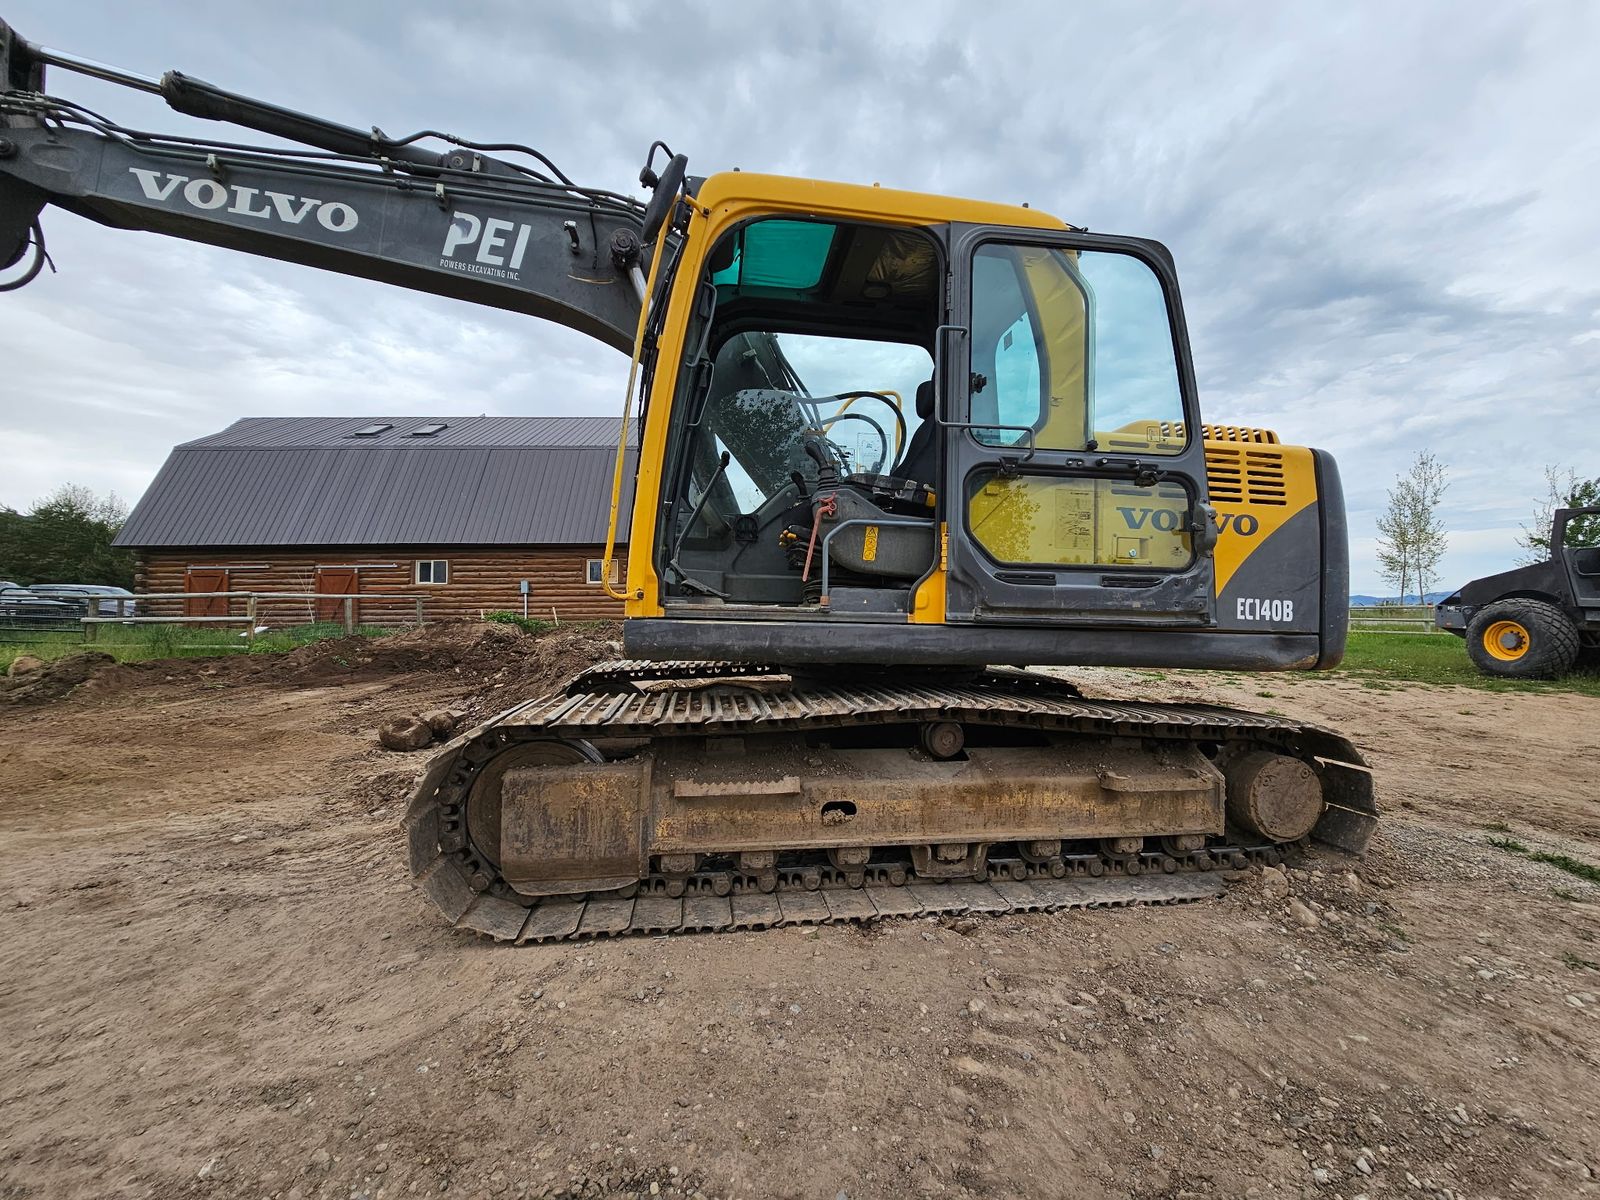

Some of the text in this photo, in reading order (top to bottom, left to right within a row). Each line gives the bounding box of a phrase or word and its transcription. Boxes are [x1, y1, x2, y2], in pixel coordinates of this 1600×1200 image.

[129, 167, 359, 232] VOLVO
[442, 211, 532, 270] PEI
[440, 258, 520, 281] POWERS EXCAVATING INC.
[1116, 506, 1259, 536] VOVO
[1236, 597, 1294, 622] EC140B
